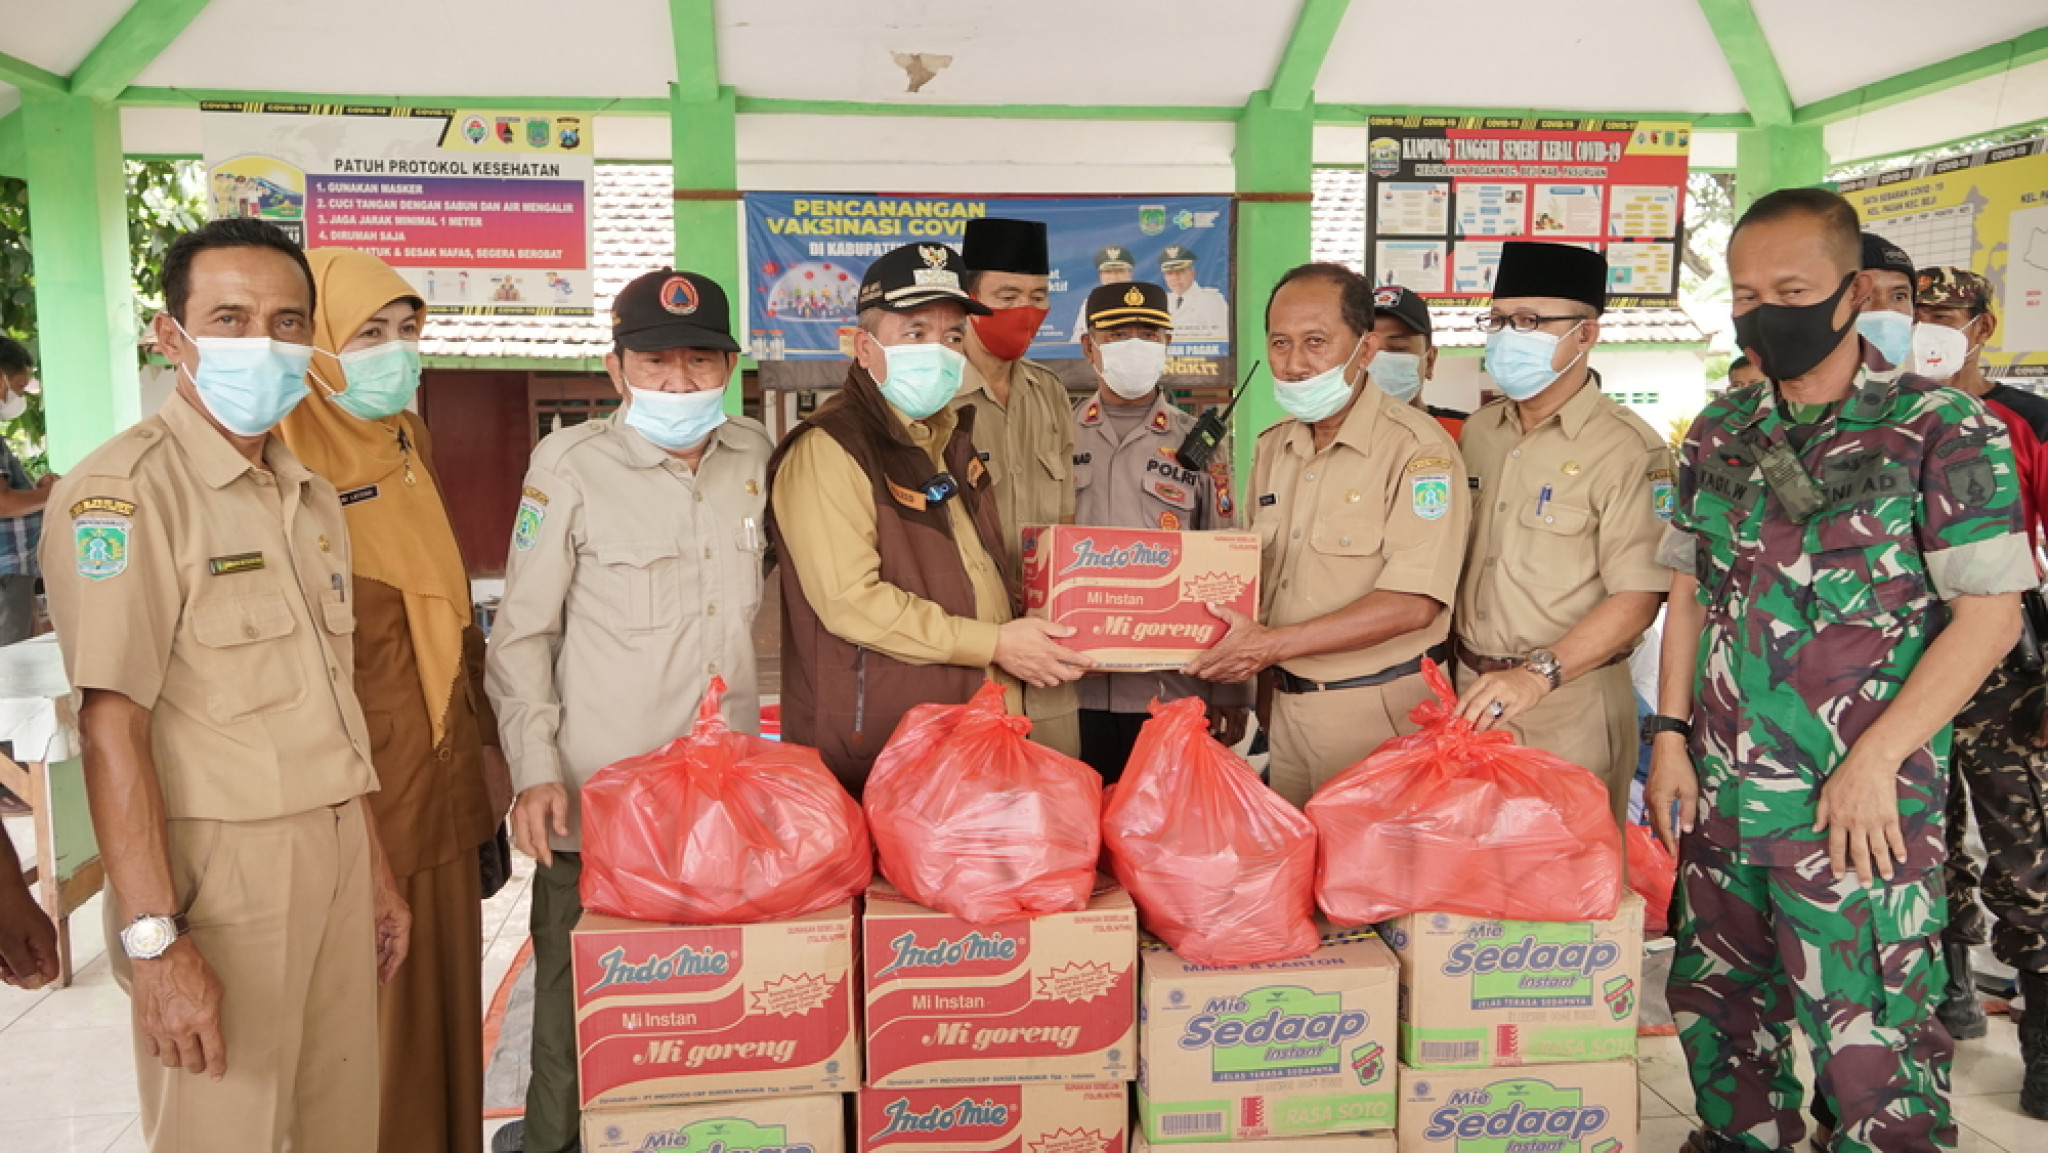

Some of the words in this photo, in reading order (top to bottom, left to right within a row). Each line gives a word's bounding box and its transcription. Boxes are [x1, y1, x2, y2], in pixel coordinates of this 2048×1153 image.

[333, 158, 384, 173] PATUH
[388, 160, 468, 175] PROTOKOL
[472, 161, 560, 177] KESEHATAN
[316, 182, 326, 192] 1.
[327, 182, 378, 194] GUNAKAN
[380, 183, 423, 195] MASKER
[316, 198, 327, 208] 2.
[329, 198, 353, 209] CUCI
[355, 199, 398, 210] TANGAN
[400, 200, 441, 211] DENGAN
[443, 201, 478, 212] SABUN
[480, 202, 501, 212] DAN
[503, 202, 521, 212] AIR
[521, 202, 574, 213] MENGALIR
[793, 199, 986, 218] PENCANANGAN
[317, 214, 328, 224] 3.
[329, 214, 357, 225] JAGA
[359, 215, 392, 225] JARAK
[394, 216, 438, 226] MINIMAL
[440, 217, 446, 226] 1
[448, 217, 484, 227] METER
[765, 217, 901, 235] VAKSINASI
[908, 219, 967, 236] COVI
[318, 230, 328, 240] 4.
[330, 231, 378, 241] DIRUMAH
[380, 231, 406, 241] SAJA
[404, 247, 437, 258] SESAK
[476, 248, 515, 258] SEGERA
[517, 249, 563, 259] BEROBAT
[808, 241, 824, 257] DI
[827, 242, 906, 257] KABUPAT
[1146, 458, 1198, 486] POLRI
[1861, 474, 1897, 495] AD
[1086, 591, 1104, 604] Mi
[1105, 592, 1144, 605] Instan
[1093, 614, 1134, 636] Mi
[1132, 619, 1215, 644] goreng
[1443, 937, 1619, 976] Sedaap
[912, 994, 932, 1010] Mi
[935, 994, 985, 1009] Instan
[1205, 997, 1249, 1013] Mie
[622, 1013, 642, 1029] Mi
[645, 1011, 697, 1027] Instan
[1179, 1010, 1368, 1048] Sedaap
[920, 1021, 973, 1047] Mi
[971, 1023, 1082, 1051] goreng
[632, 1039, 684, 1066] Mi
[684, 1038, 797, 1068] goreng
[1449, 1089, 1490, 1106] Mie
[1286, 1105, 1332, 1125] RASA
[1338, 1101, 1388, 1120] SOTO
[1424, 1101, 1609, 1141] Sedaap
[644, 1131, 688, 1149] Mie
